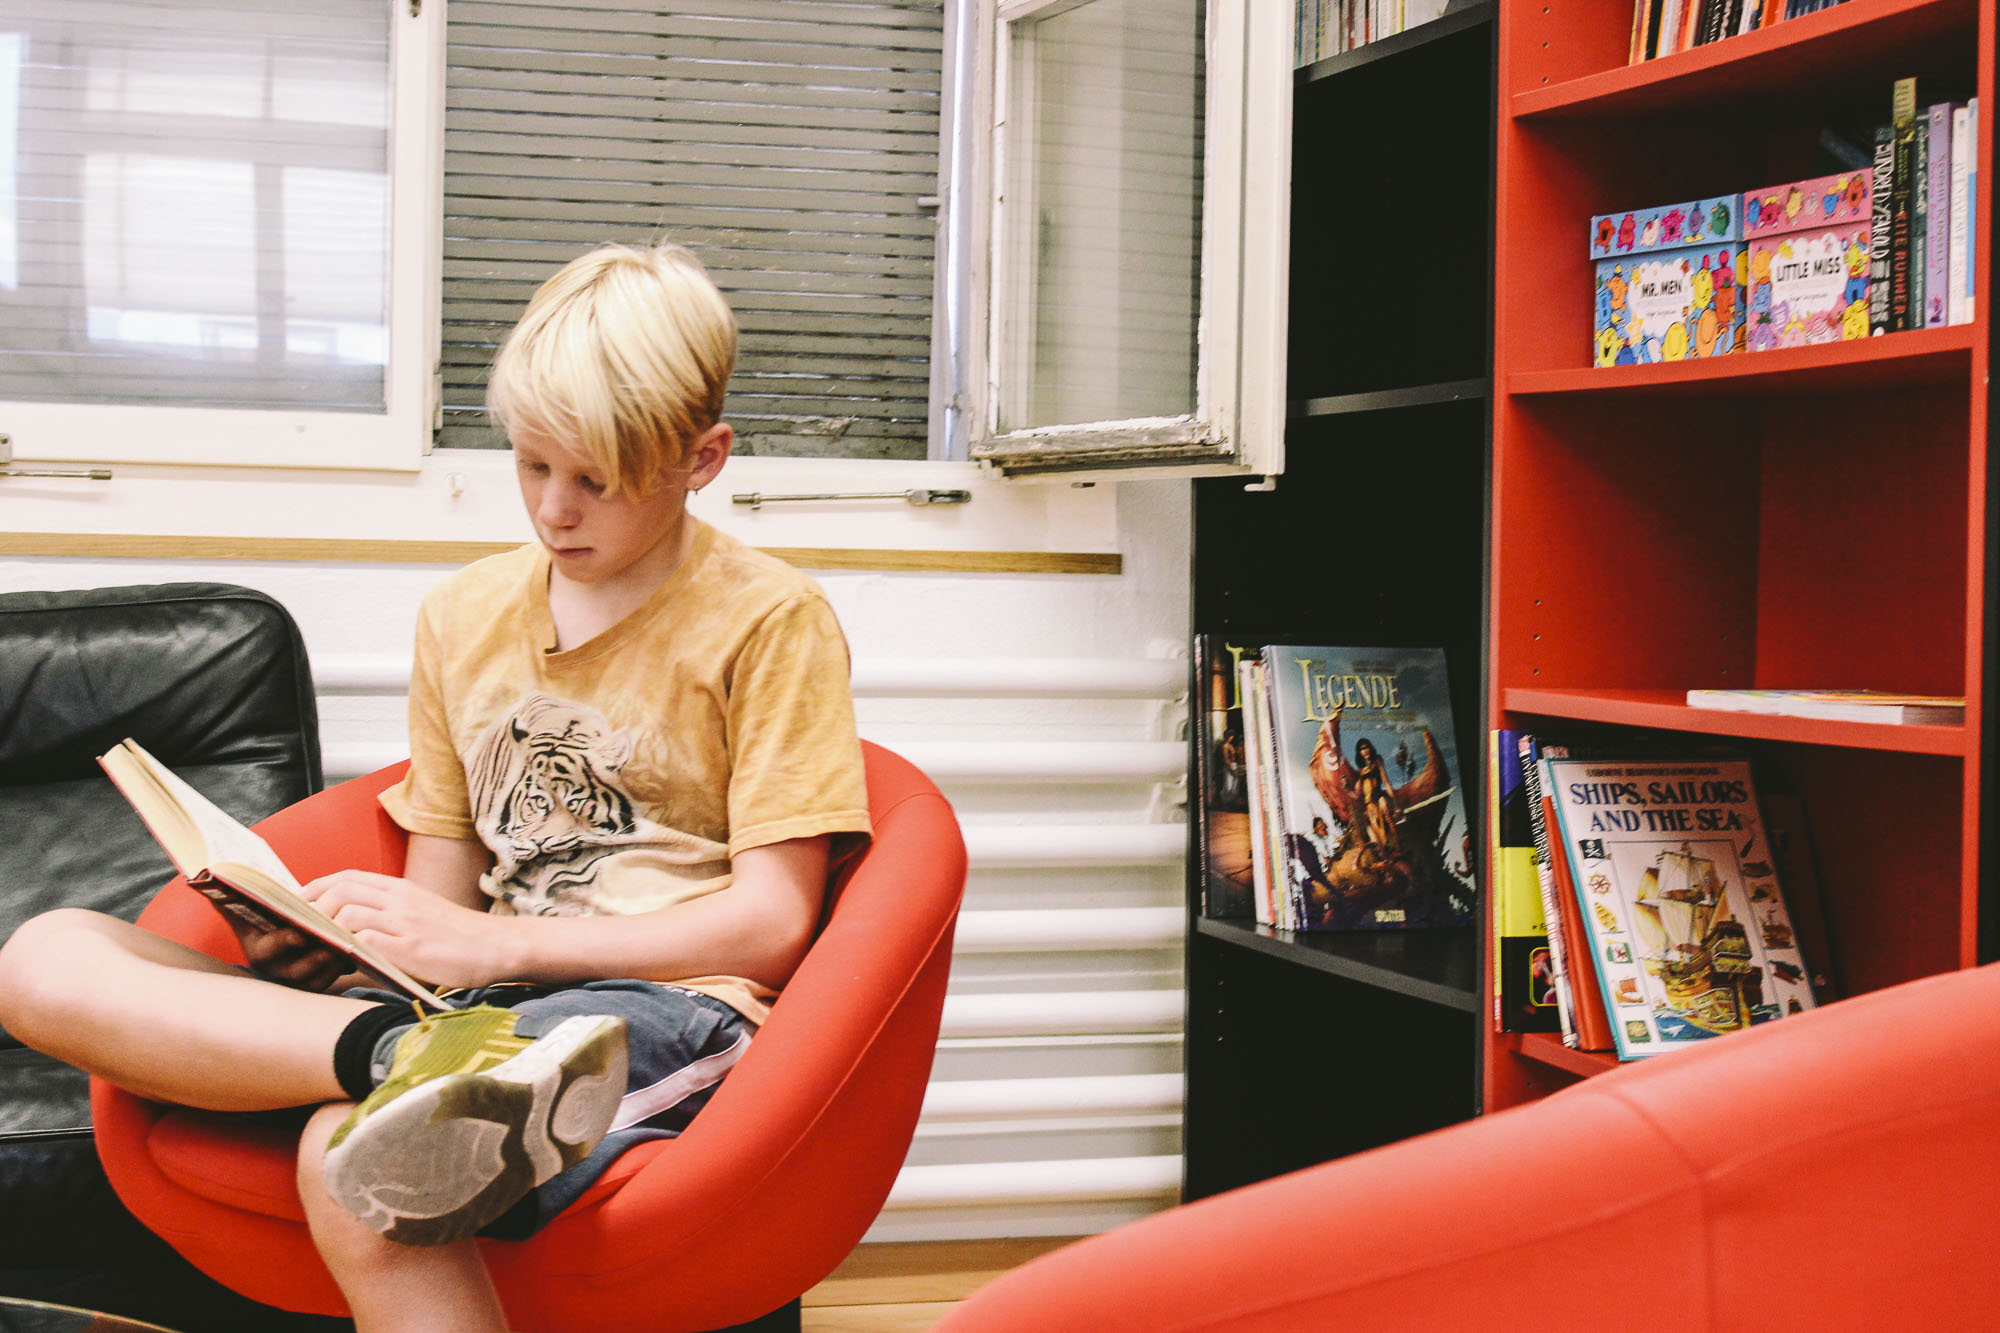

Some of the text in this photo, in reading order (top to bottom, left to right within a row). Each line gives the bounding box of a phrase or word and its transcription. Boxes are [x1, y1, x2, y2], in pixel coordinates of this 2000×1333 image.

[1894, 209, 1908, 248] KITE
[1777, 256, 1840, 282] LITTLE MISS
[1893, 249, 1908, 316] RUNNER
[1641, 279, 1683, 297] MR. MEN
[1292, 653, 1401, 722] LEGENDE
[1569, 780, 1749, 808] SHIPS, SAILORS
[1590, 807, 1744, 833] AND THE SEA
